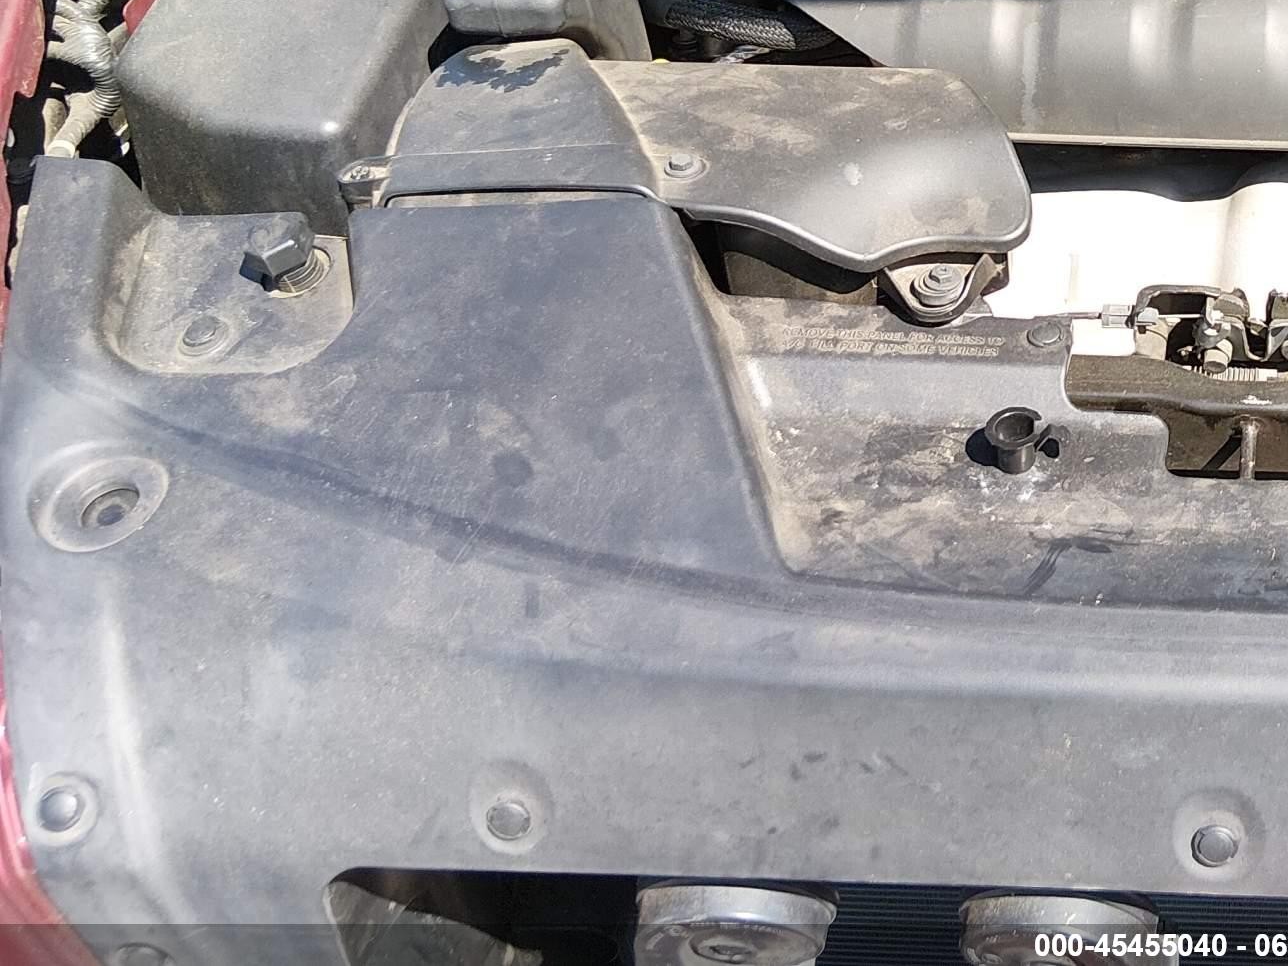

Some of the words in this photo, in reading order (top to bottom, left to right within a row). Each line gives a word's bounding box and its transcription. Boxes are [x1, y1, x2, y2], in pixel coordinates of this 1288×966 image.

[837, 328, 867, 340] THIS
[868, 330, 906, 341] PANEL
[907, 331, 935, 343] FOR
[935, 333, 986, 345] ACCESS
[839, 340, 874, 352] PORT
[875, 341, 897, 353] ON
[897, 343, 937, 355] SOME
[937, 345, 1000, 357] VEHICLES
